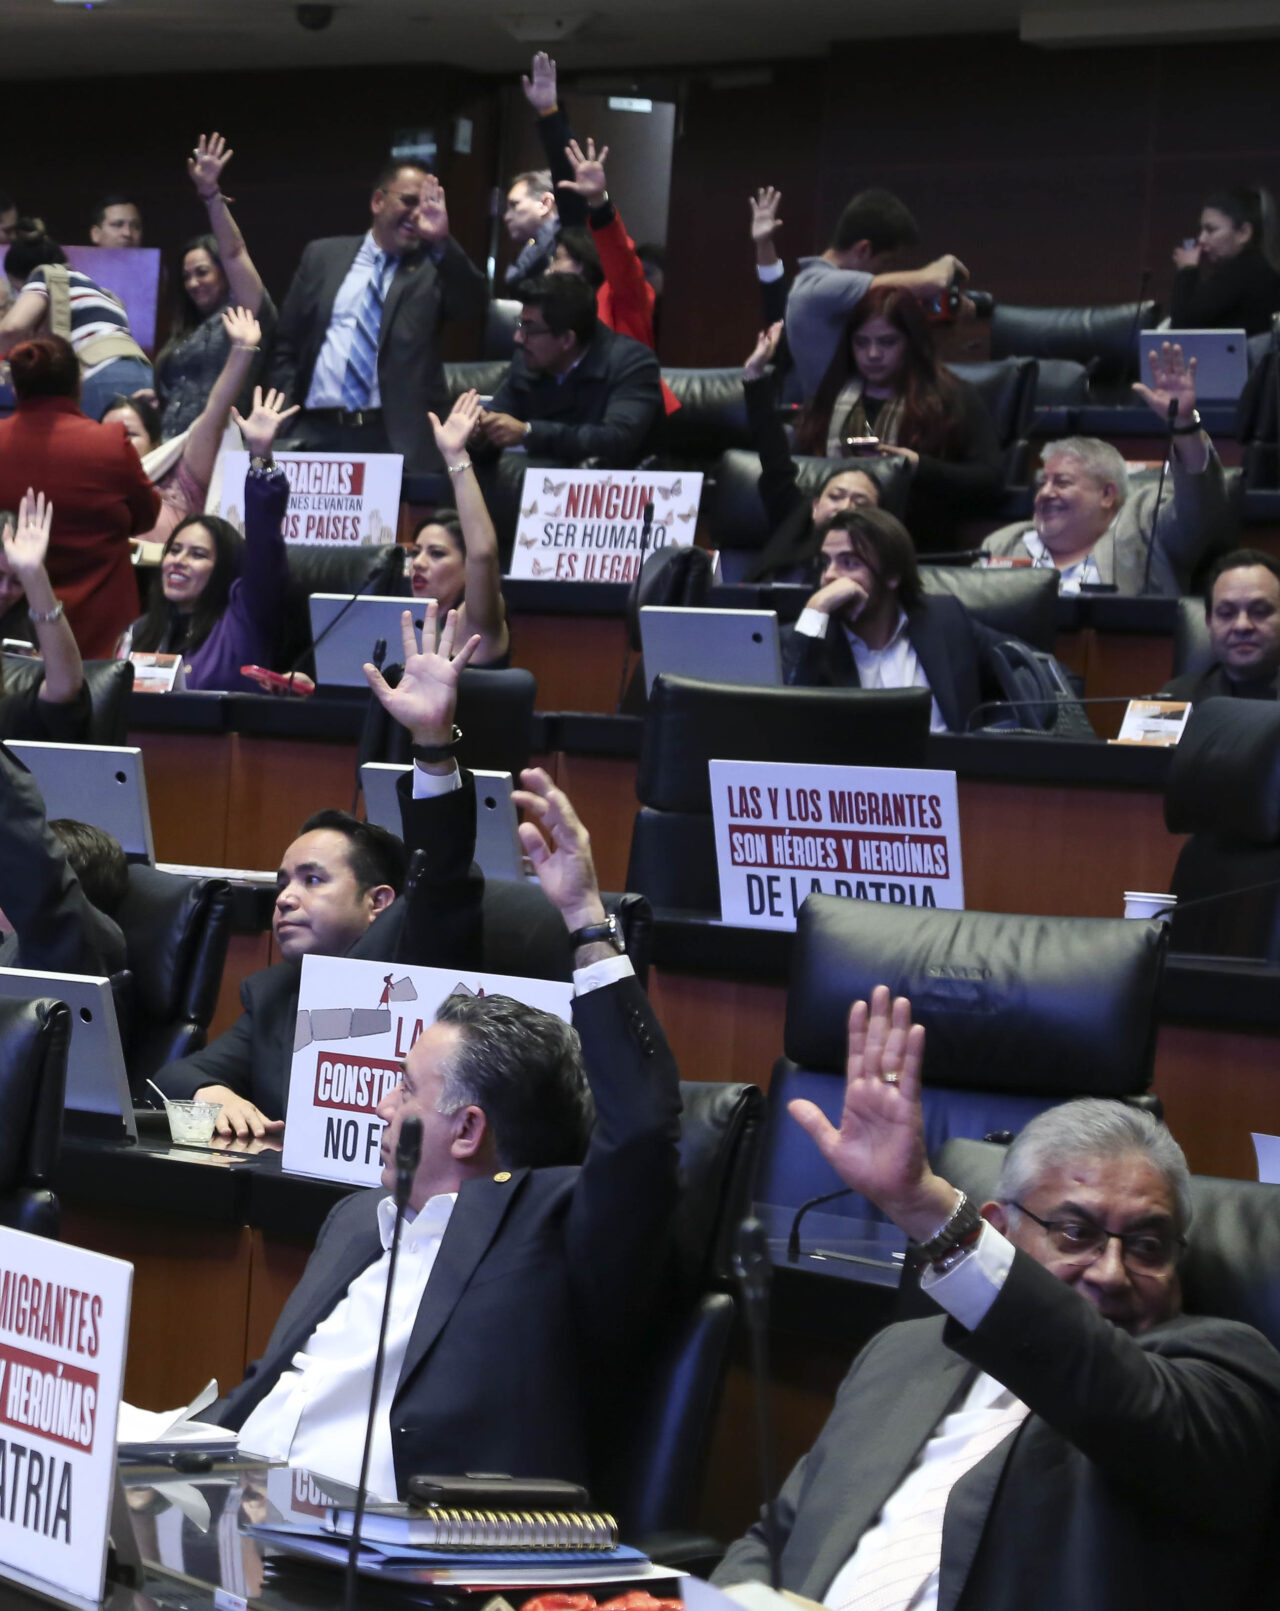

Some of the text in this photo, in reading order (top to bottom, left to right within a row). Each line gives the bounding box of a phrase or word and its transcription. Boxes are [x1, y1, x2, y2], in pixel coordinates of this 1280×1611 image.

[312, 497, 363, 511] LEVANTAN
[565, 477, 655, 520] NINGÚN
[541, 522, 578, 548] SER
[555, 553, 579, 580] ES
[727, 785, 942, 829] LAS Y LOS MIGRANTES
[732, 828, 947, 875] SON HÉROES Y HEROÍNAS
[746, 873, 784, 917] DE
[395, 1016, 424, 1058] LA
[318, 1061, 403, 1108] CONSTR
[324, 1116, 384, 1167] NO F
[6, 1363, 96, 1446] HEROÍNAS
